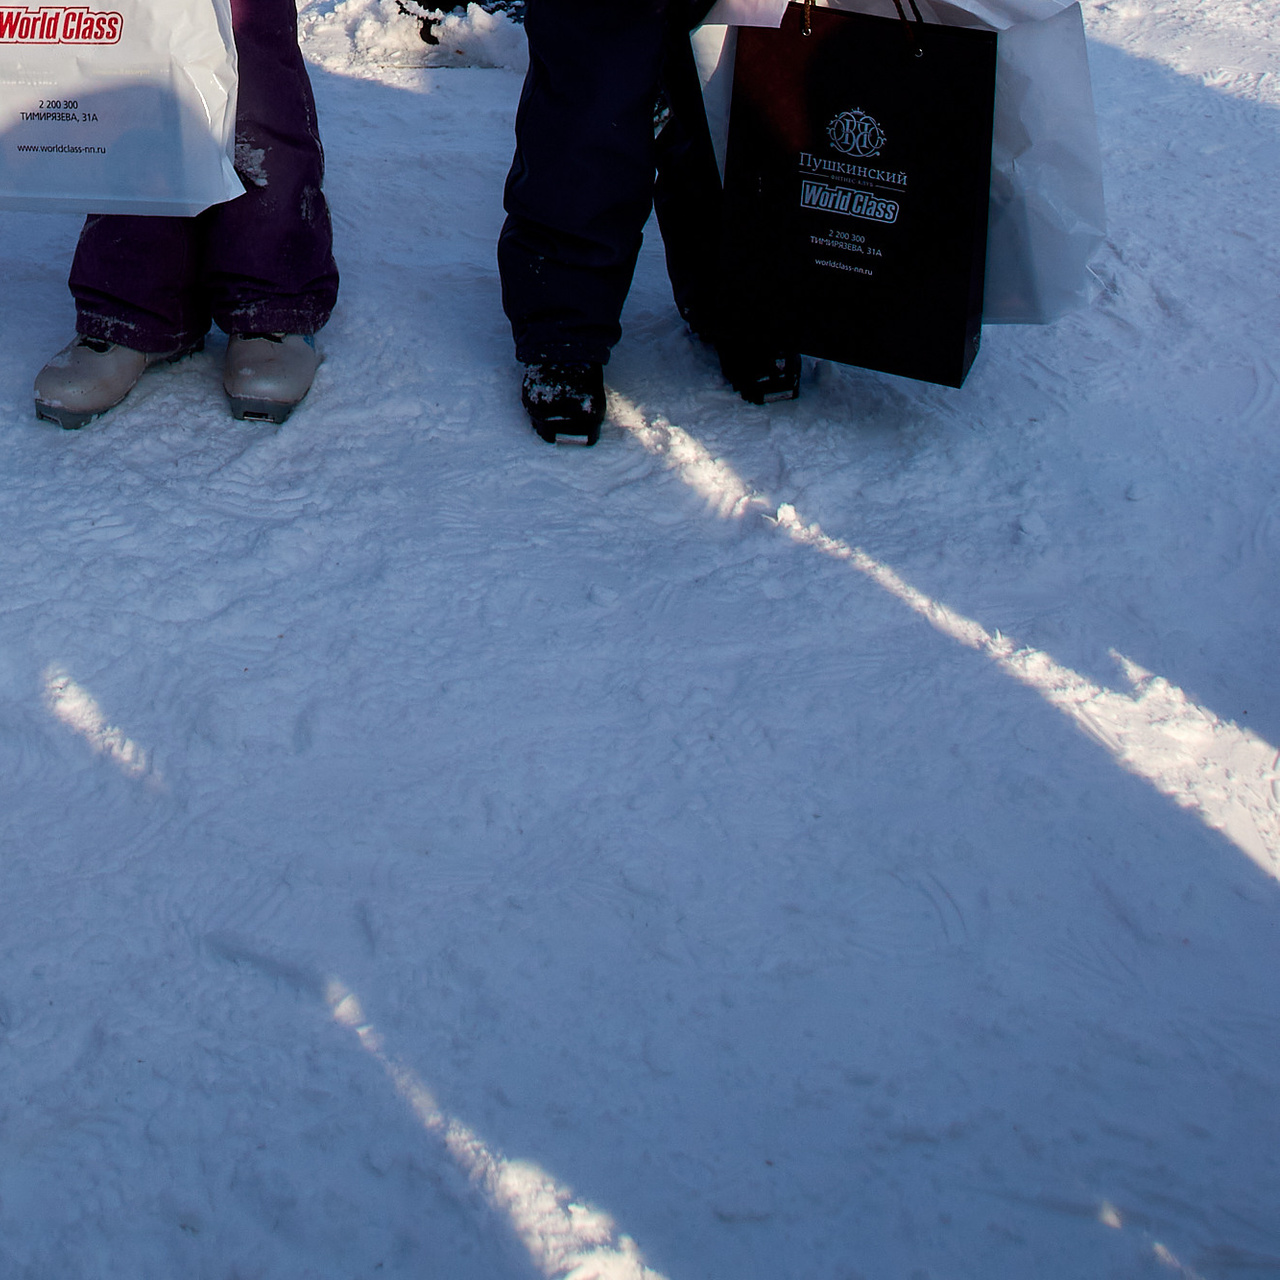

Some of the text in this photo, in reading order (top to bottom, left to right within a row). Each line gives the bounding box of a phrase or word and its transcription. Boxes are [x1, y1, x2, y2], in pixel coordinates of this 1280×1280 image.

[62, 10, 119, 40] Class
[39, 100, 78, 109] 2 200 300
[20, 112, 80, 122] ТИМИРЯЗЕВА,
[17, 144, 106, 154] www.worldclass-nn.ru
[798, 152, 908, 186] Пушкинский
[804, 183, 896, 220] World Class
[810, 235, 864, 254] ТИМИРЯЗЕВА,
[835, 230, 850, 240] 200
[851, 233, 866, 244] 300
[815, 259, 873, 276] worldclass-nn.ru
